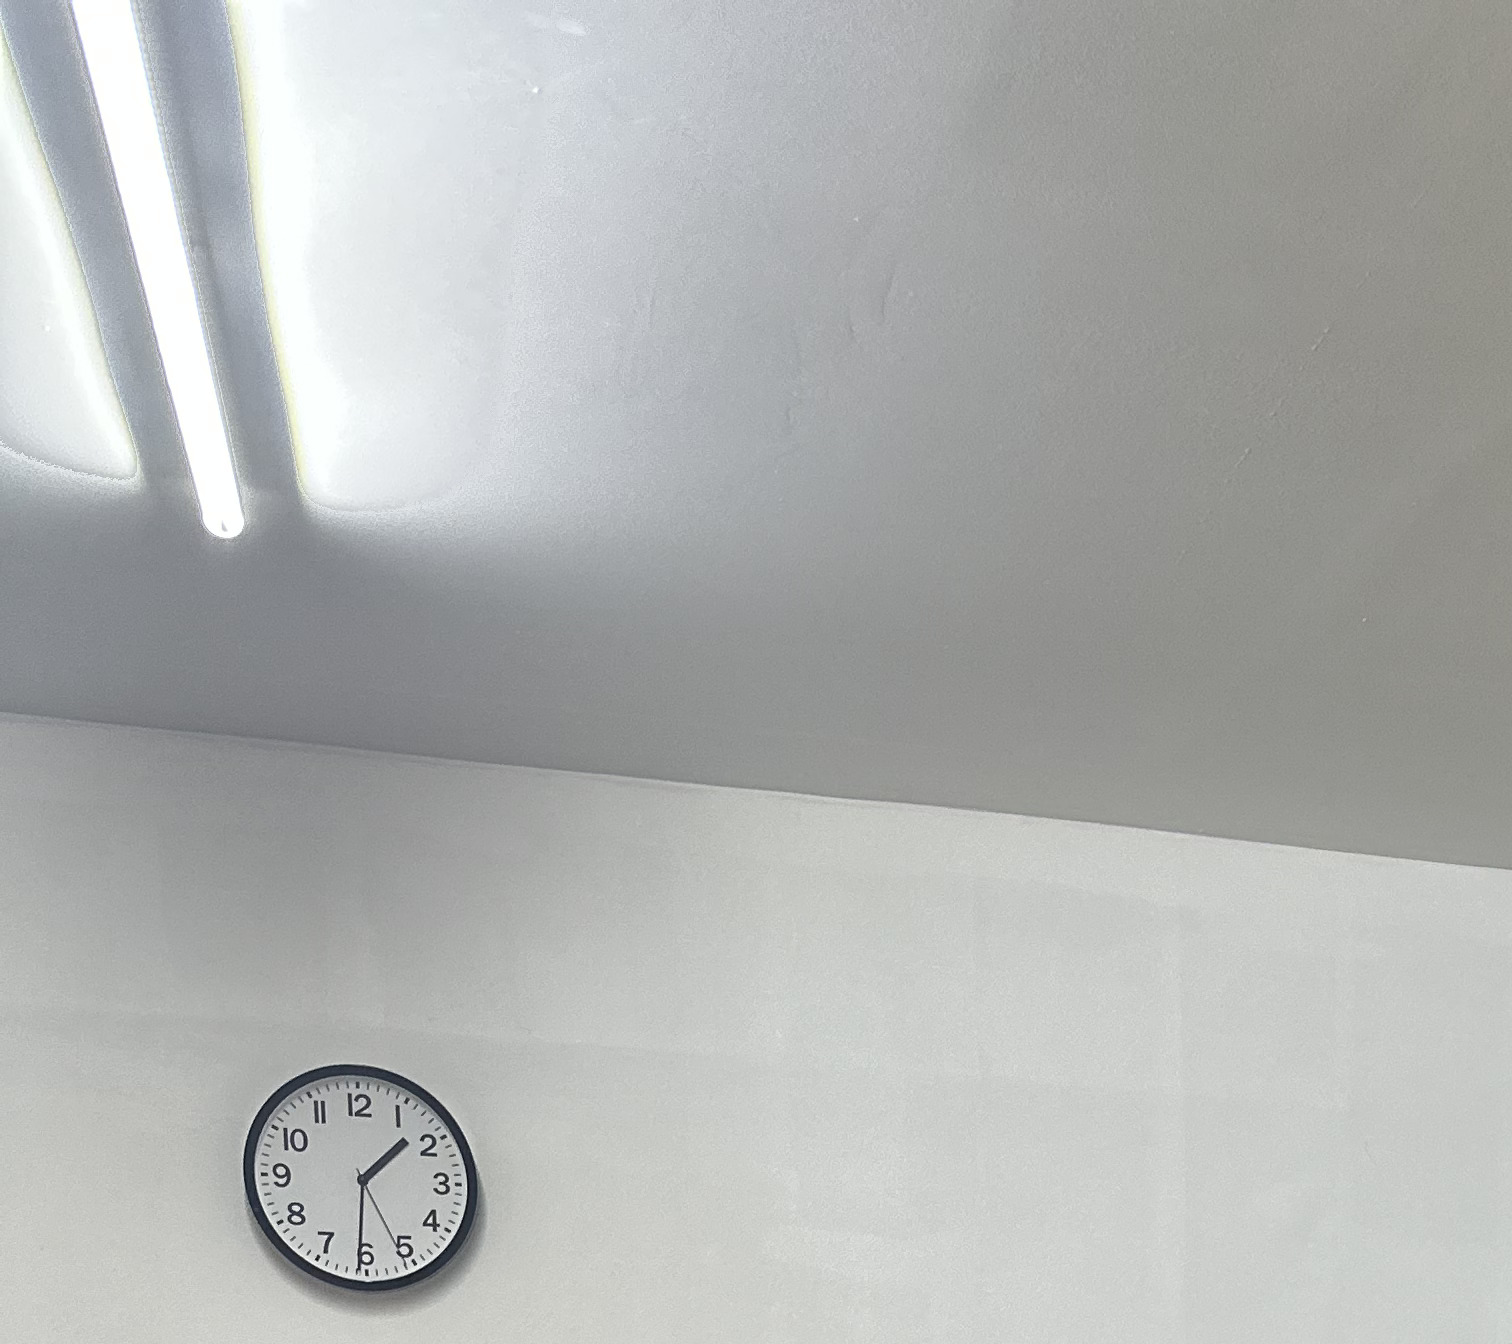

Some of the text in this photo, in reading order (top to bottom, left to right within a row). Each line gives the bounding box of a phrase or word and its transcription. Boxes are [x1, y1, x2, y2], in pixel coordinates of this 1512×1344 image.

[313, 1100, 327, 1124] 11
[347, 1092, 373, 1117] 12
[394, 1104, 401, 1128] 1
[283, 1127, 309, 1152] 10
[419, 1133, 438, 1157] 2
[272, 1162, 291, 1188] 9
[432, 1172, 450, 1195] 3
[286, 1202, 306, 1225] 8
[422, 1209, 441, 1232] 4
[317, 1231, 335, 1254] 7
[395, 1235, 414, 1258] 5
[358, 1243, 375, 1266] 6
